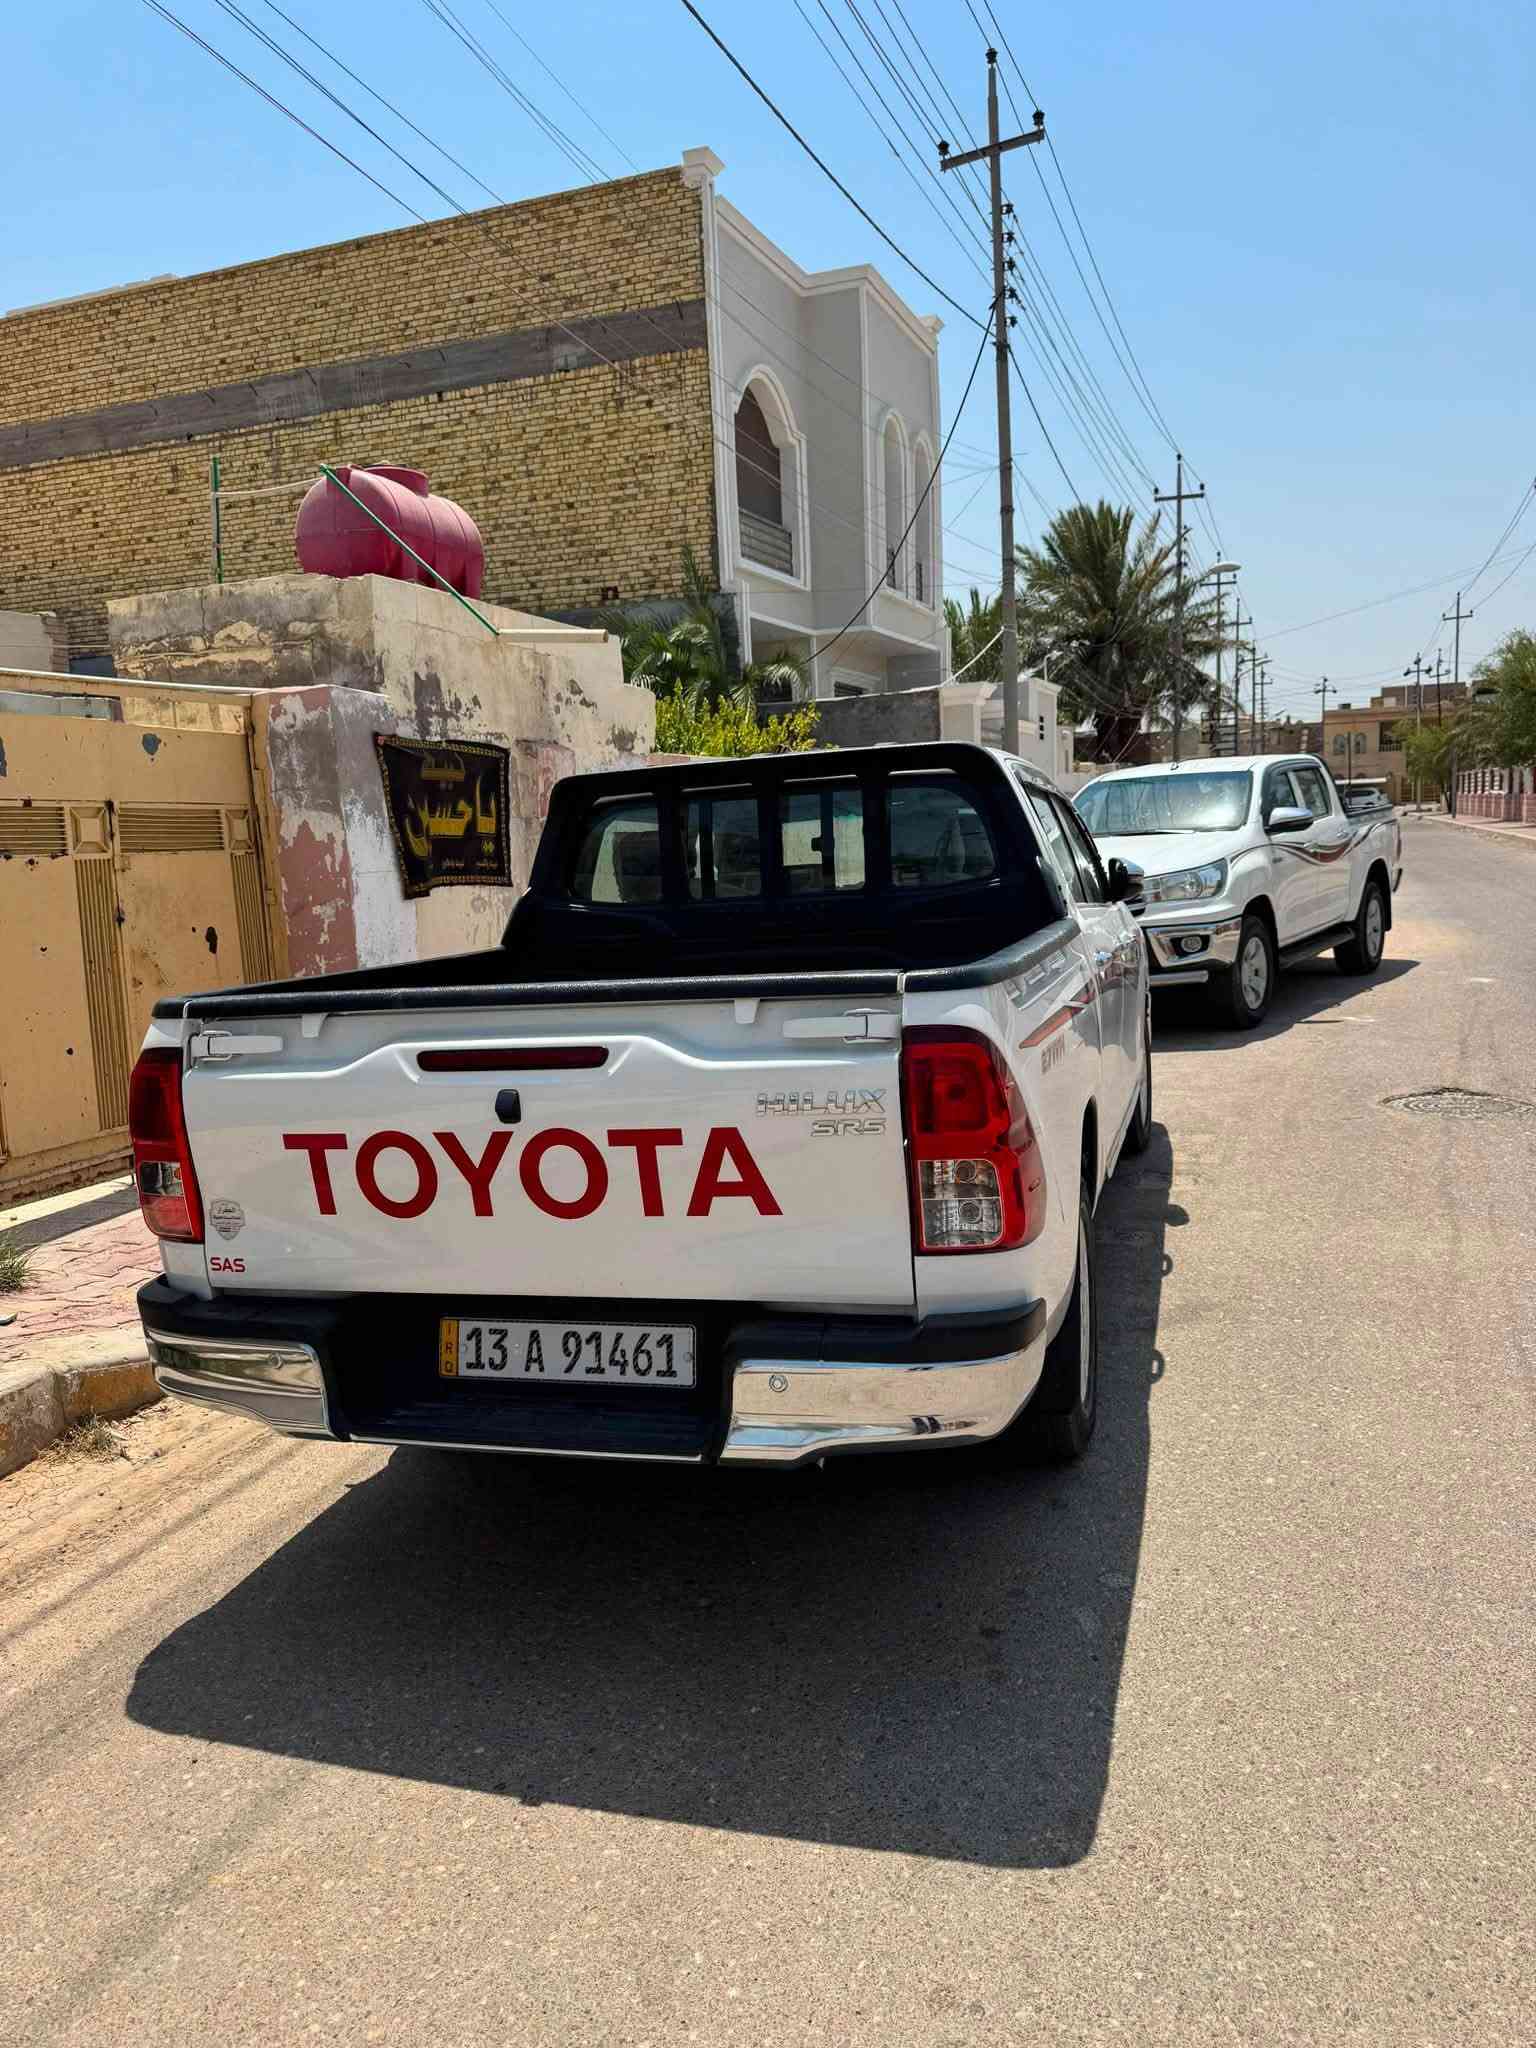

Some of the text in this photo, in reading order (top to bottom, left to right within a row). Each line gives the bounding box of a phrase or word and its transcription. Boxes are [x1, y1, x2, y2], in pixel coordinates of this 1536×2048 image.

[756, 1089, 887, 1117] HILUX
[811, 1118, 887, 1137] SR5
[281, 1126, 785, 1220] TOYOTA
[209, 1256, 247, 1273] SAS
[465, 1327, 678, 1378] 13 A 91461
